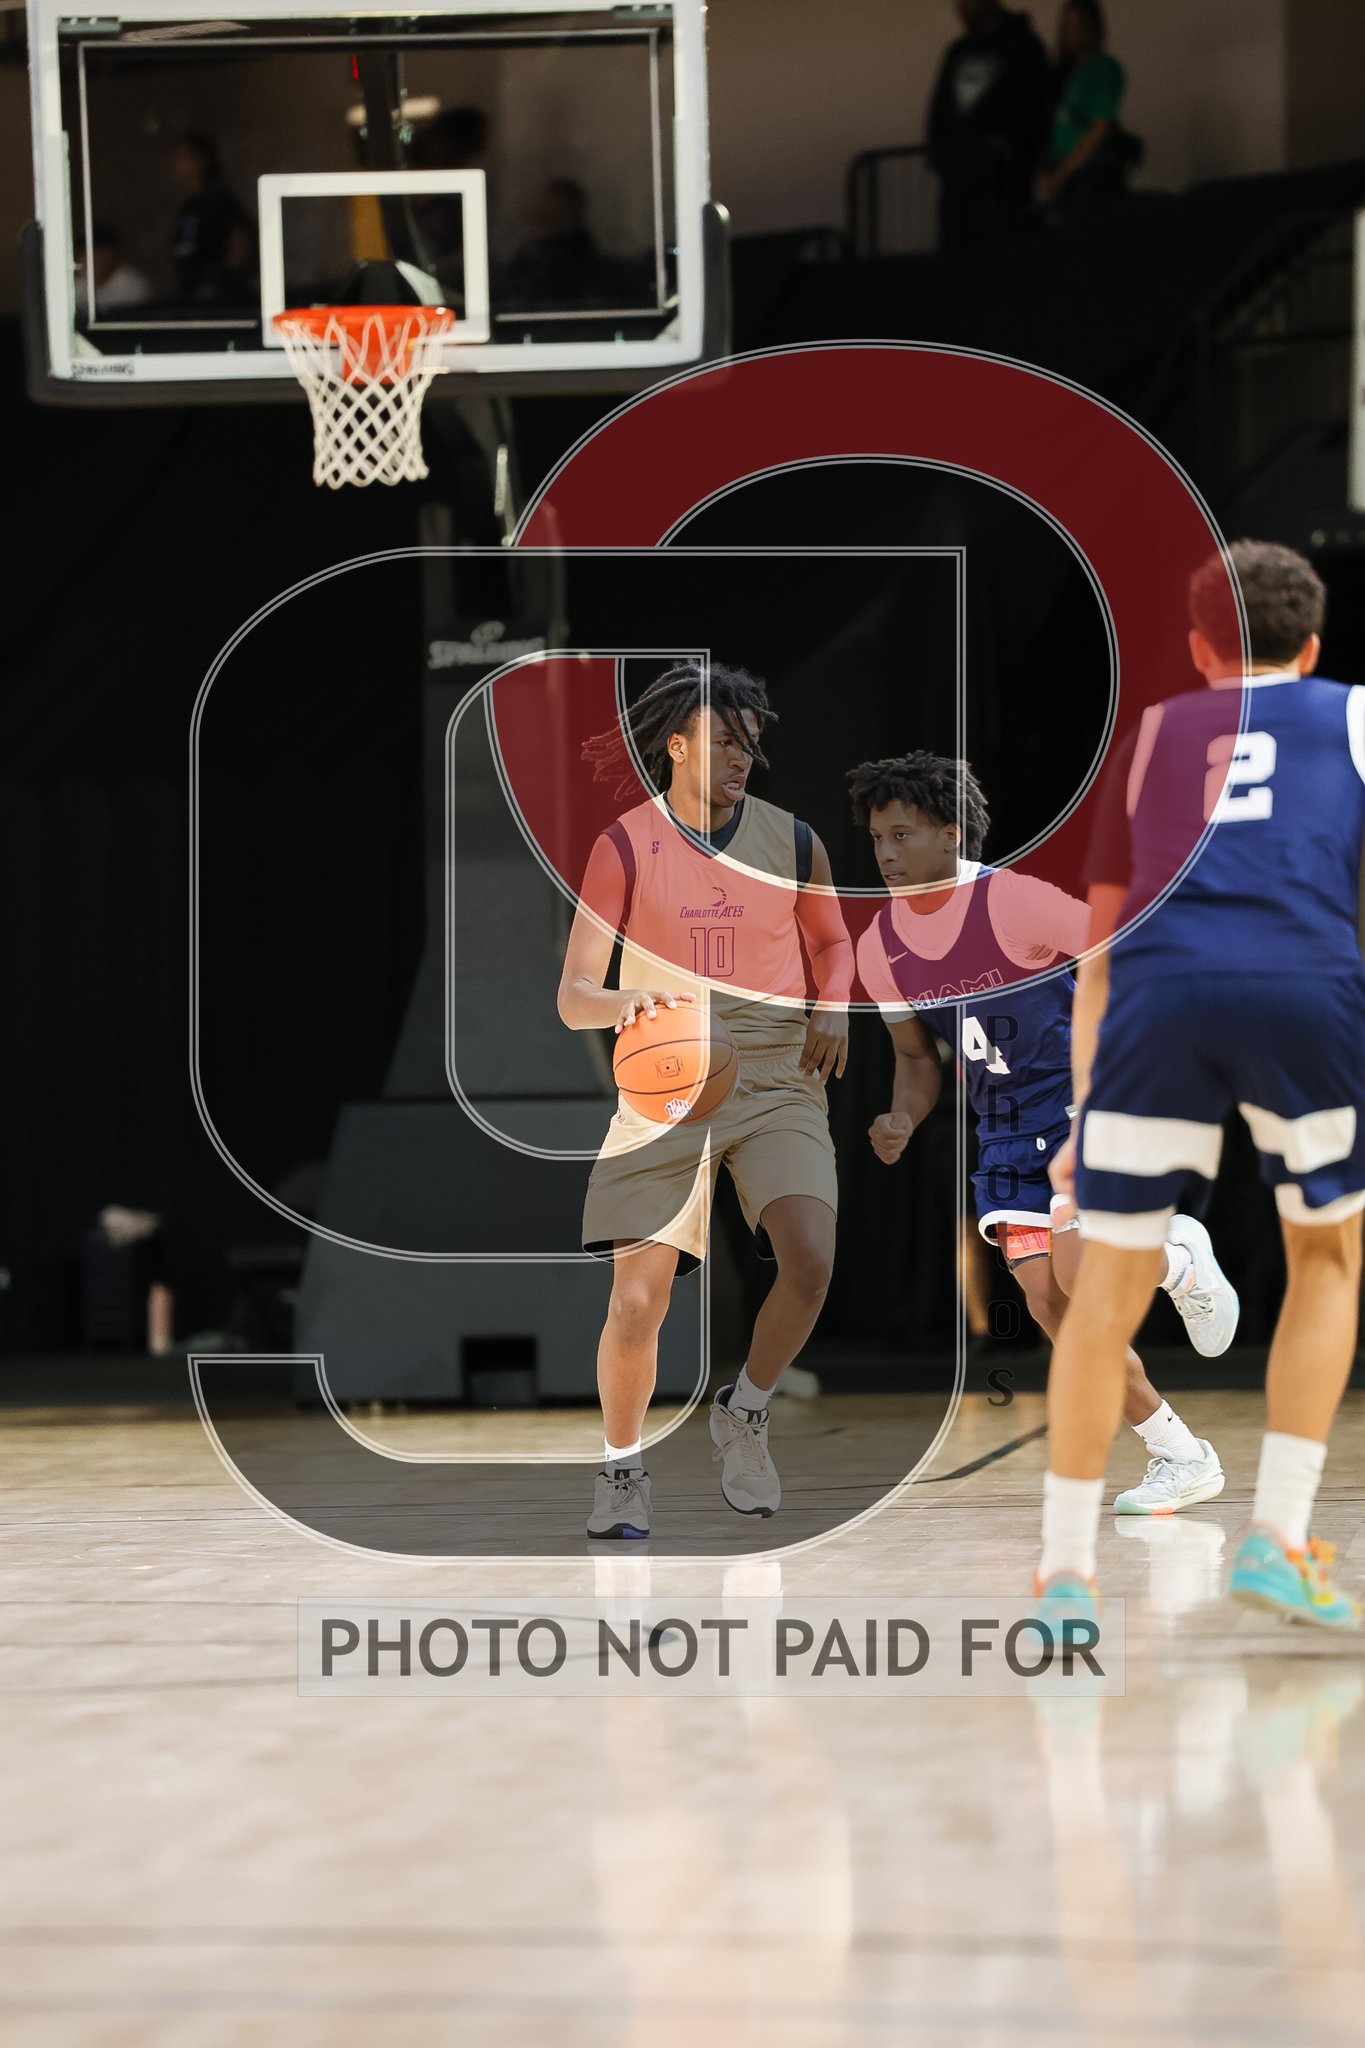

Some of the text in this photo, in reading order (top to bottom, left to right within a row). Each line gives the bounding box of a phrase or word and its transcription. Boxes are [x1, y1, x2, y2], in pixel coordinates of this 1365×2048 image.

[1203, 730, 1278, 825] 2
[718, 905, 745, 920] ACES
[690, 926, 735, 978] 10
[906, 968, 1004, 1010] MIAMI
[962, 1016, 1011, 1075] 4
